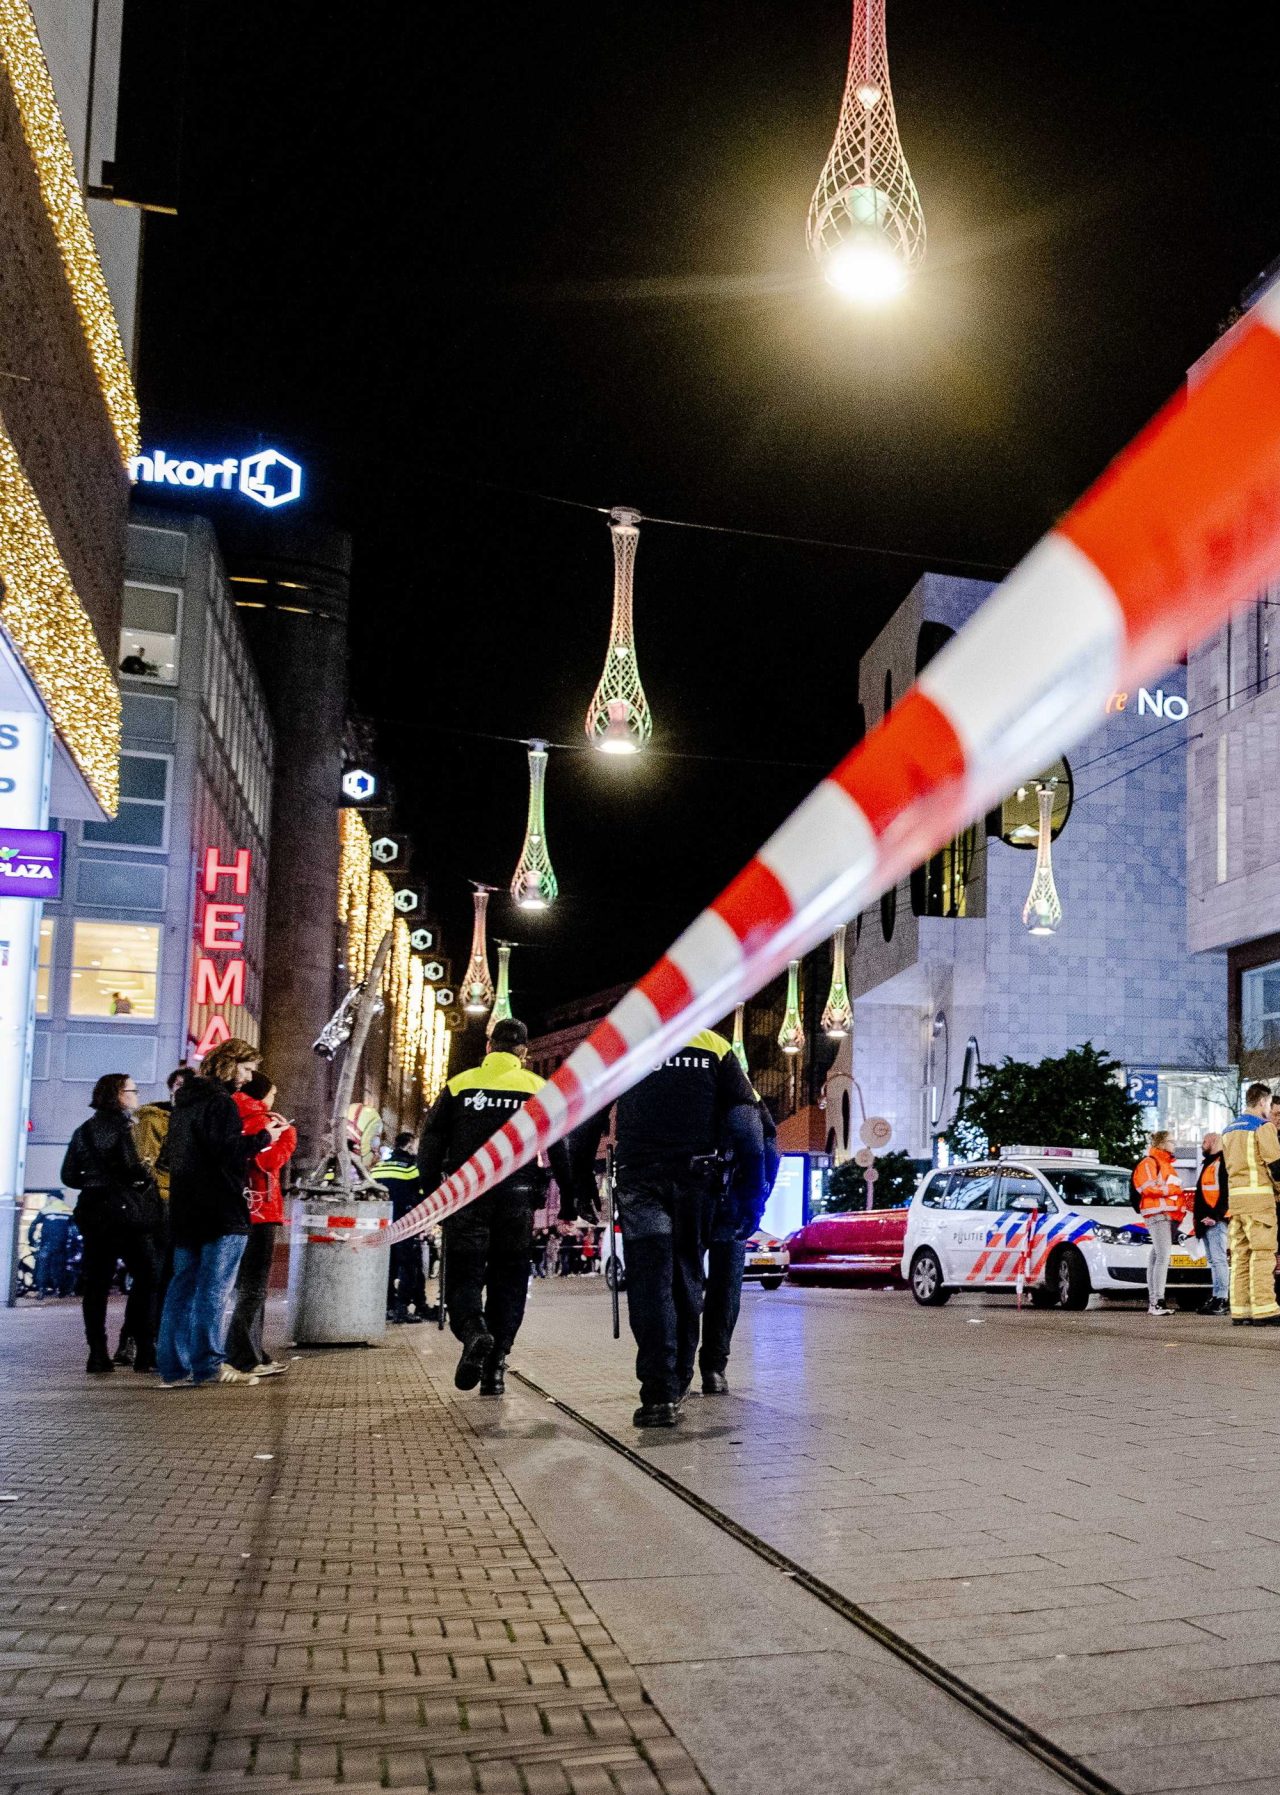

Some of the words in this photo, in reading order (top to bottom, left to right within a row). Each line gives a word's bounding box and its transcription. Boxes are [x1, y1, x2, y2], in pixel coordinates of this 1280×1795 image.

[129, 450, 239, 490] nkorf
[1138, 687, 1189, 721] No
[194, 848, 251, 1060] HEMA
[653, 1056, 710, 1071] LITIE
[953, 1233, 984, 1244] POLITIE
